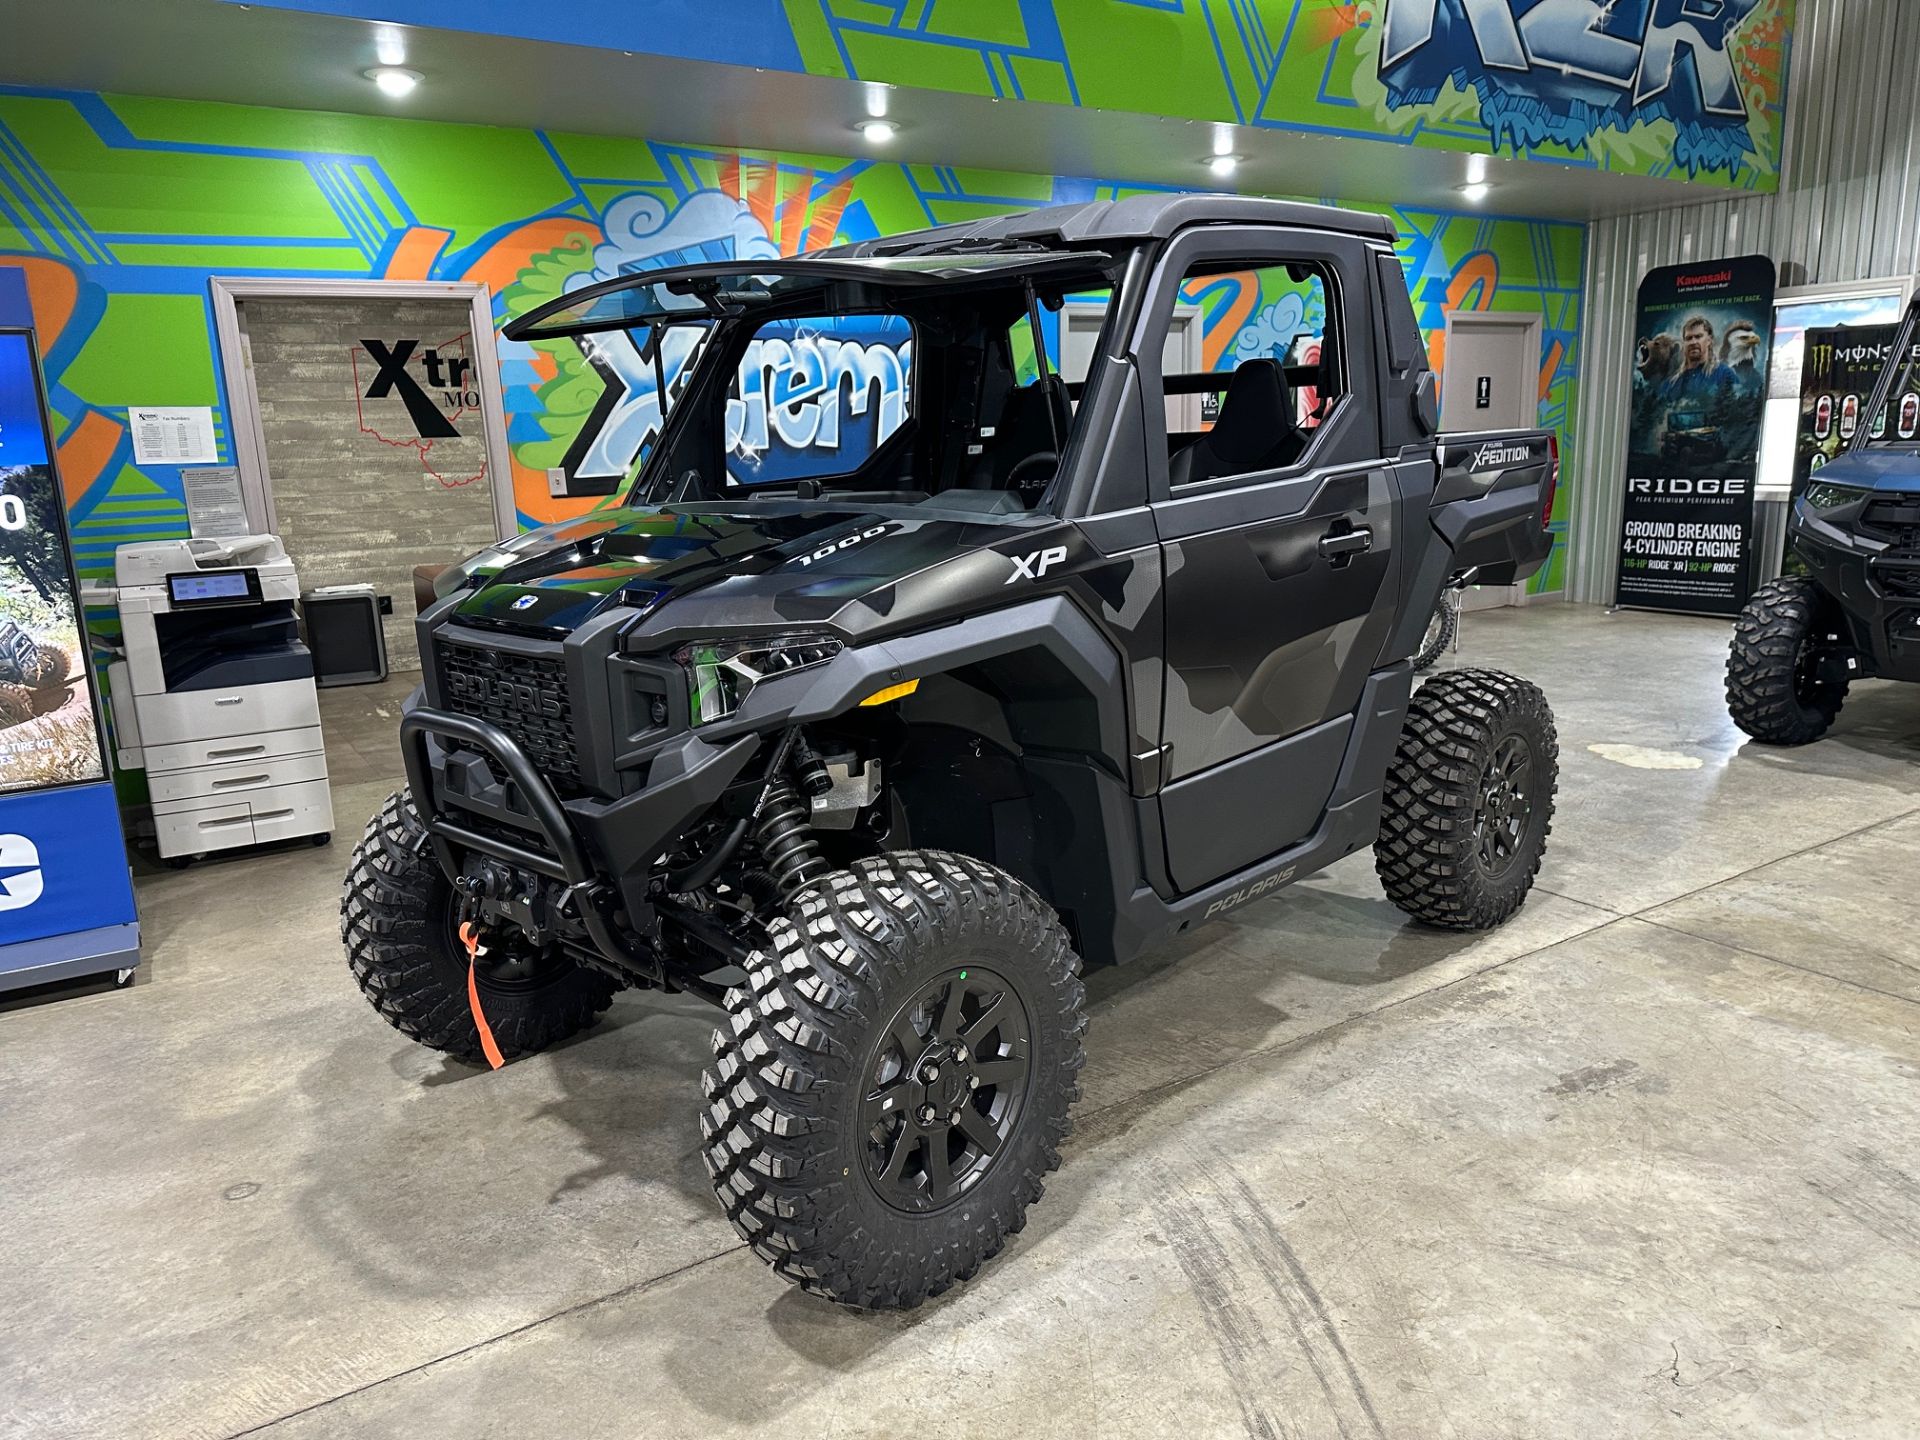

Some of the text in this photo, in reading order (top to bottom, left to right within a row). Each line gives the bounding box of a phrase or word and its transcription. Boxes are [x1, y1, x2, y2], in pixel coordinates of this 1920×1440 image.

[1676, 271, 1731, 287] Kawasaki
[1847, 361, 1920, 372] ENEGY
[360, 339, 479, 438] Xtr
[1469, 443, 1529, 473] XPEDITION
[1686, 497, 1735, 505] PERFORMANCE
[1625, 521, 1741, 540] GROUND BREAKING
[799, 525, 886, 567] 1000
[1623, 538, 1741, 558] 4-CYLINDER ENGINE
[1003, 545, 1067, 585] XP
[1623, 558, 1648, 569] 116-HP
[1673, 560, 1684, 570] XR
[1688, 562, 1713, 573] 92-HP
[445, 671, 561, 719] POLARIS
[10, 741, 36, 752] TIRE
[37, 738, 55, 748] KIT
[1204, 865, 1297, 919] POLARIS
